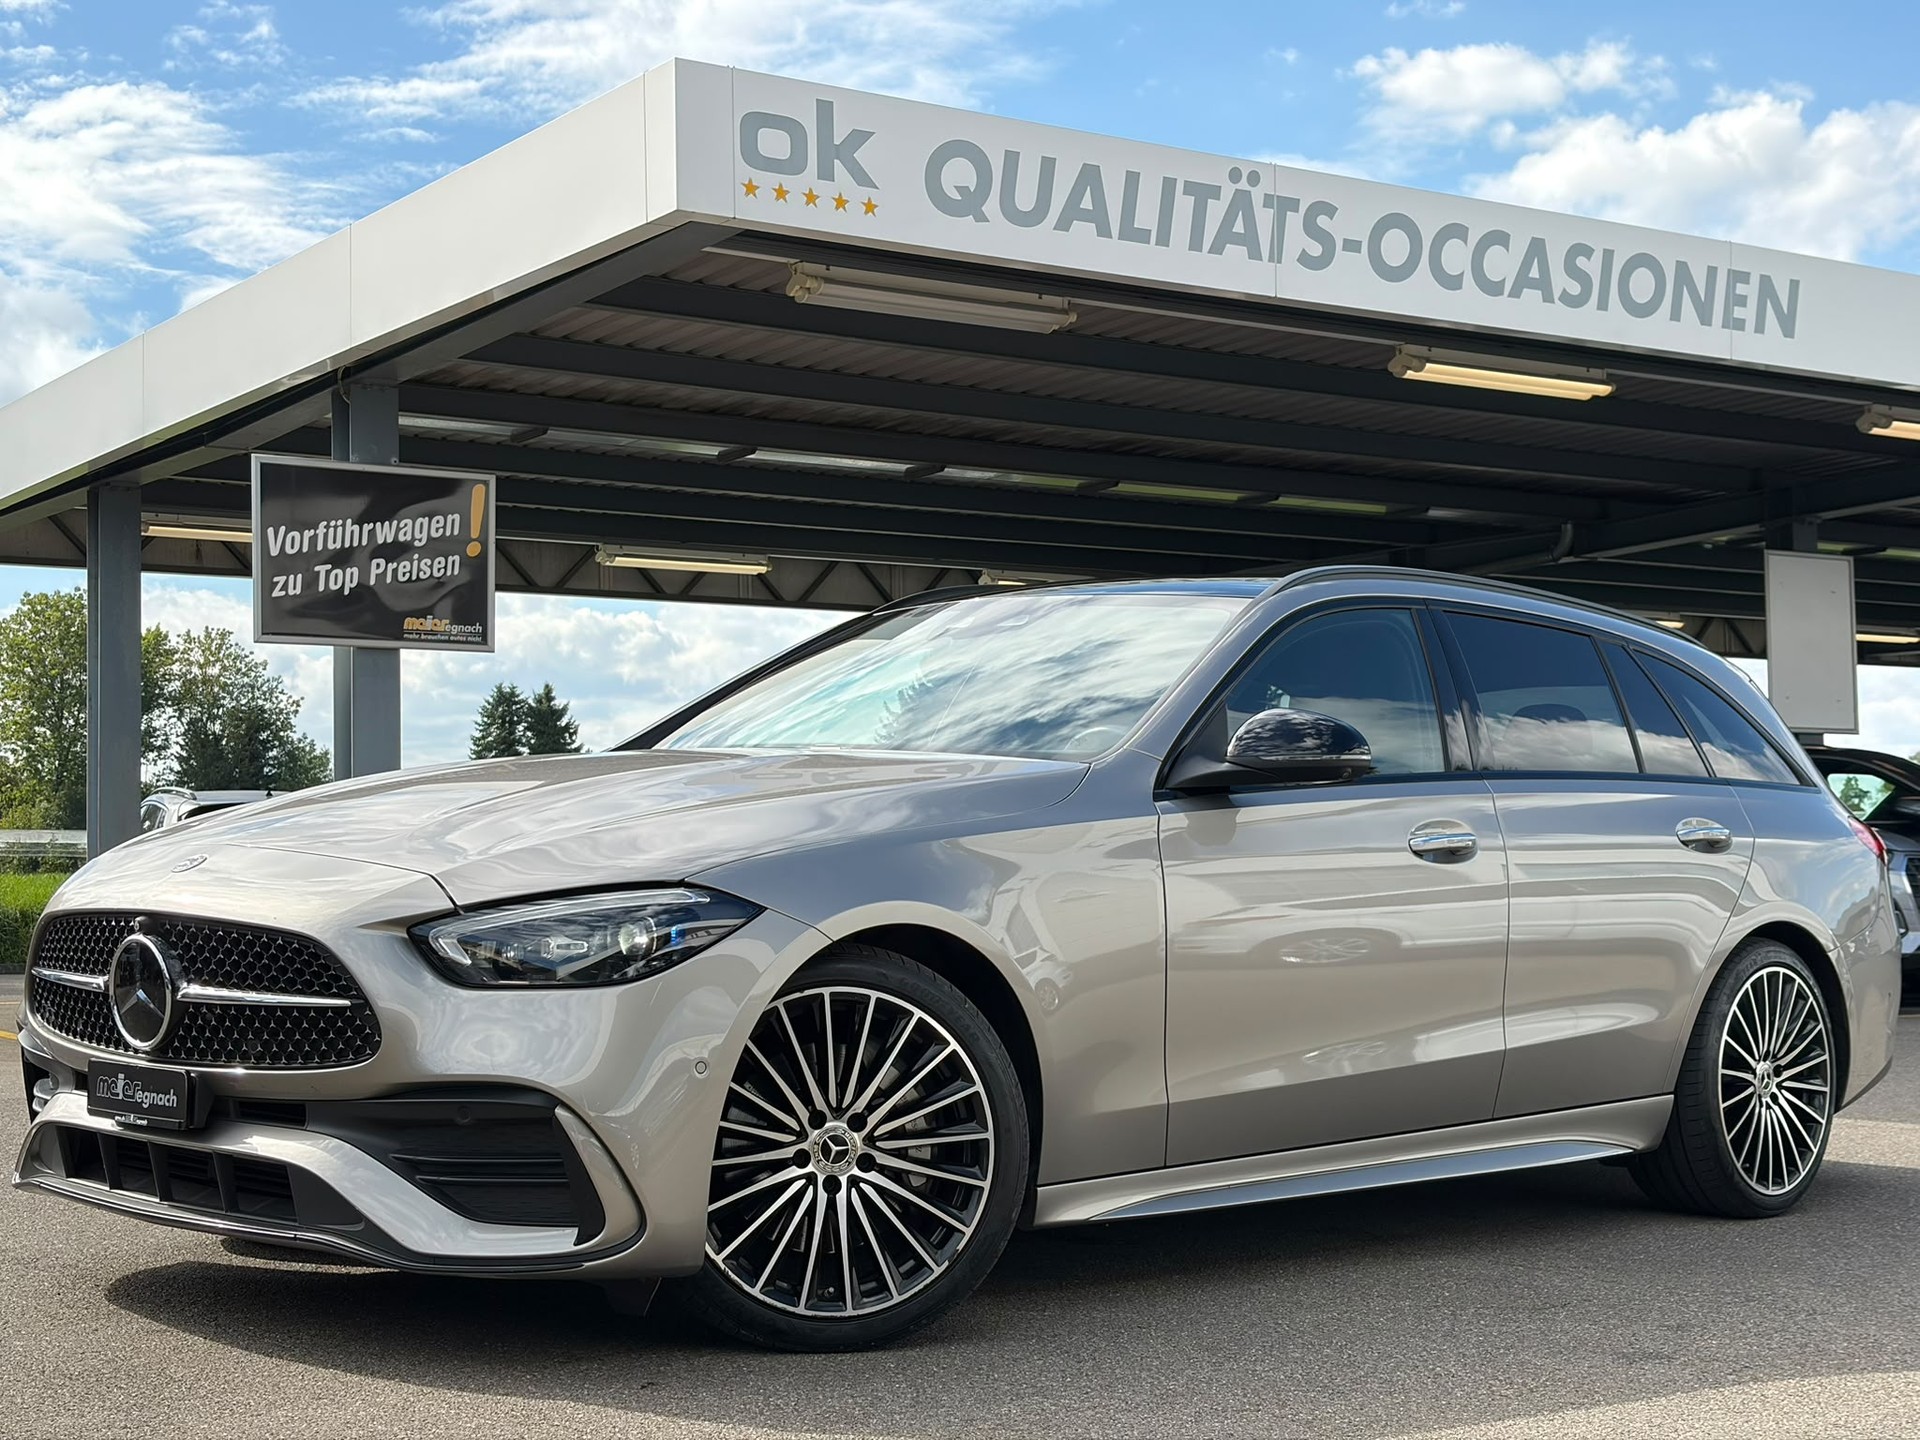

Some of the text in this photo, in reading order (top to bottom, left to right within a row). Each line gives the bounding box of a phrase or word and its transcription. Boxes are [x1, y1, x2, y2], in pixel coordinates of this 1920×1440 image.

[739, 98, 1801, 340] ok QUALITÄTS-OCCASIONEN
[266, 512, 461, 557] Vorführwagen
[271, 553, 461, 598] zu Top Preisen
